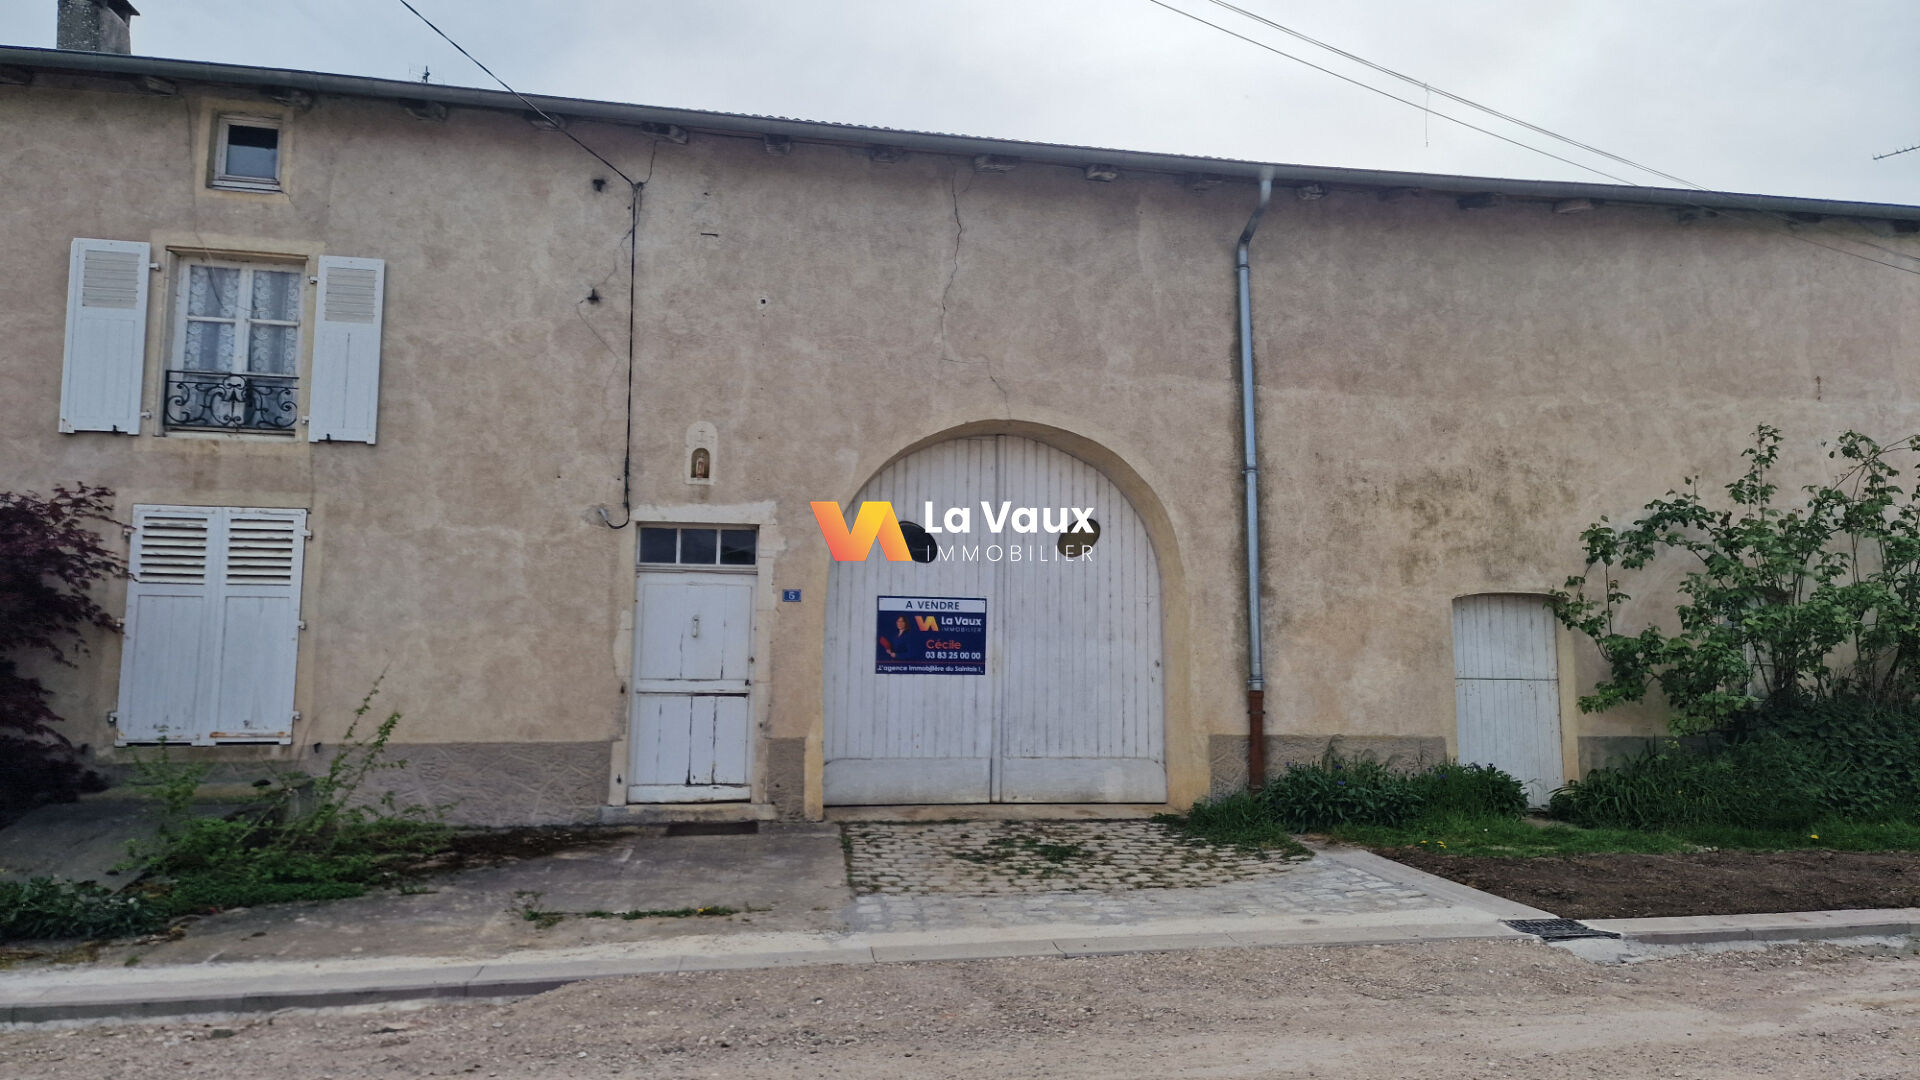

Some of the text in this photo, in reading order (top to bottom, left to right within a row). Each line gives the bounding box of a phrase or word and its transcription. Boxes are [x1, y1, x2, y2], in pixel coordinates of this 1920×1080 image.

[905, 600, 960, 610] A VENDRE
[941, 616, 982, 626] La Vaux
[926, 639, 962, 650] Cécile
[925, 651, 981, 660] 03 83 25 00 00
